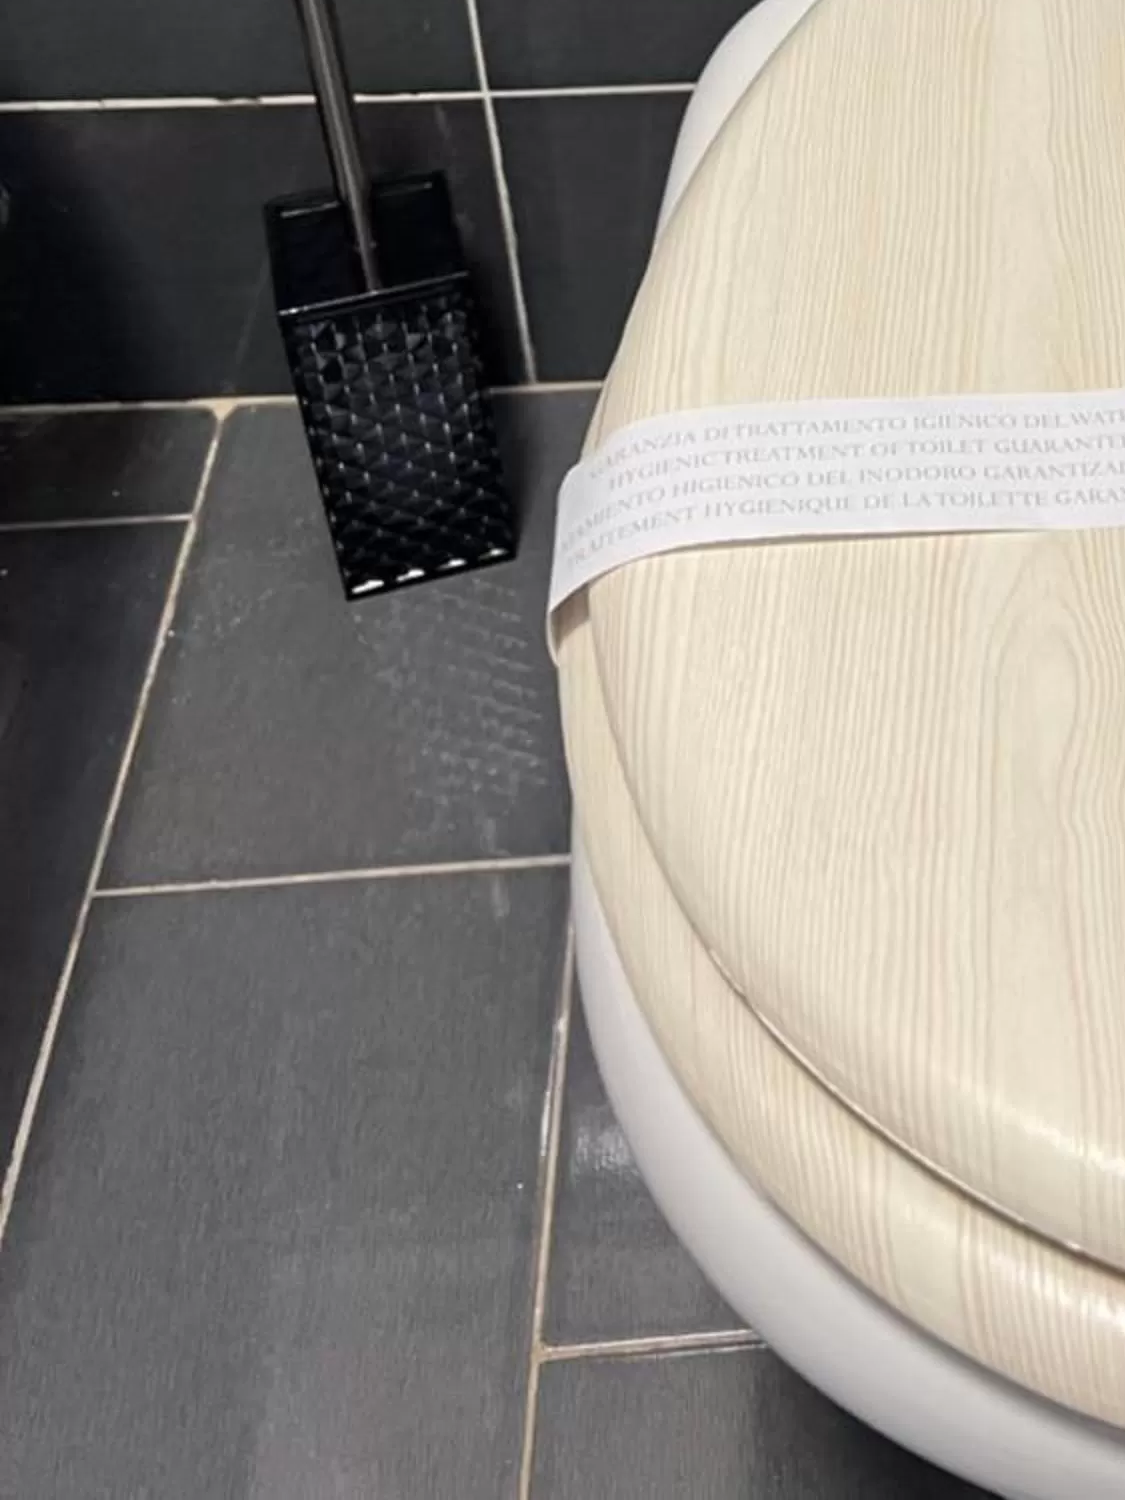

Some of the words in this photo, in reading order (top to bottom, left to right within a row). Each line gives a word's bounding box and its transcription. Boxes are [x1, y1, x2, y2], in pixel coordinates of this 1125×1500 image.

[703, 426, 729, 441] DI
[734, 417, 908, 438] TRATTAMENTO
[913, 411, 1017, 431] IGIENICO
[1024, 412, 1069, 430] DEL
[608, 452, 720, 491] HYGIENIC
[723, 442, 863, 466] TREATMENT
[869, 440, 900, 458] OF
[905, 438, 985, 456] TOILET
[671, 473, 800, 498] HIGIENICO
[807, 470, 853, 486] DEL
[859, 464, 977, 484] INODORO
[704, 496, 853, 518] HYGIENIQUE
[863, 493, 896, 510] DE
[902, 491, 932, 508] LA
[934, 488, 1045, 509] TOILETTE
